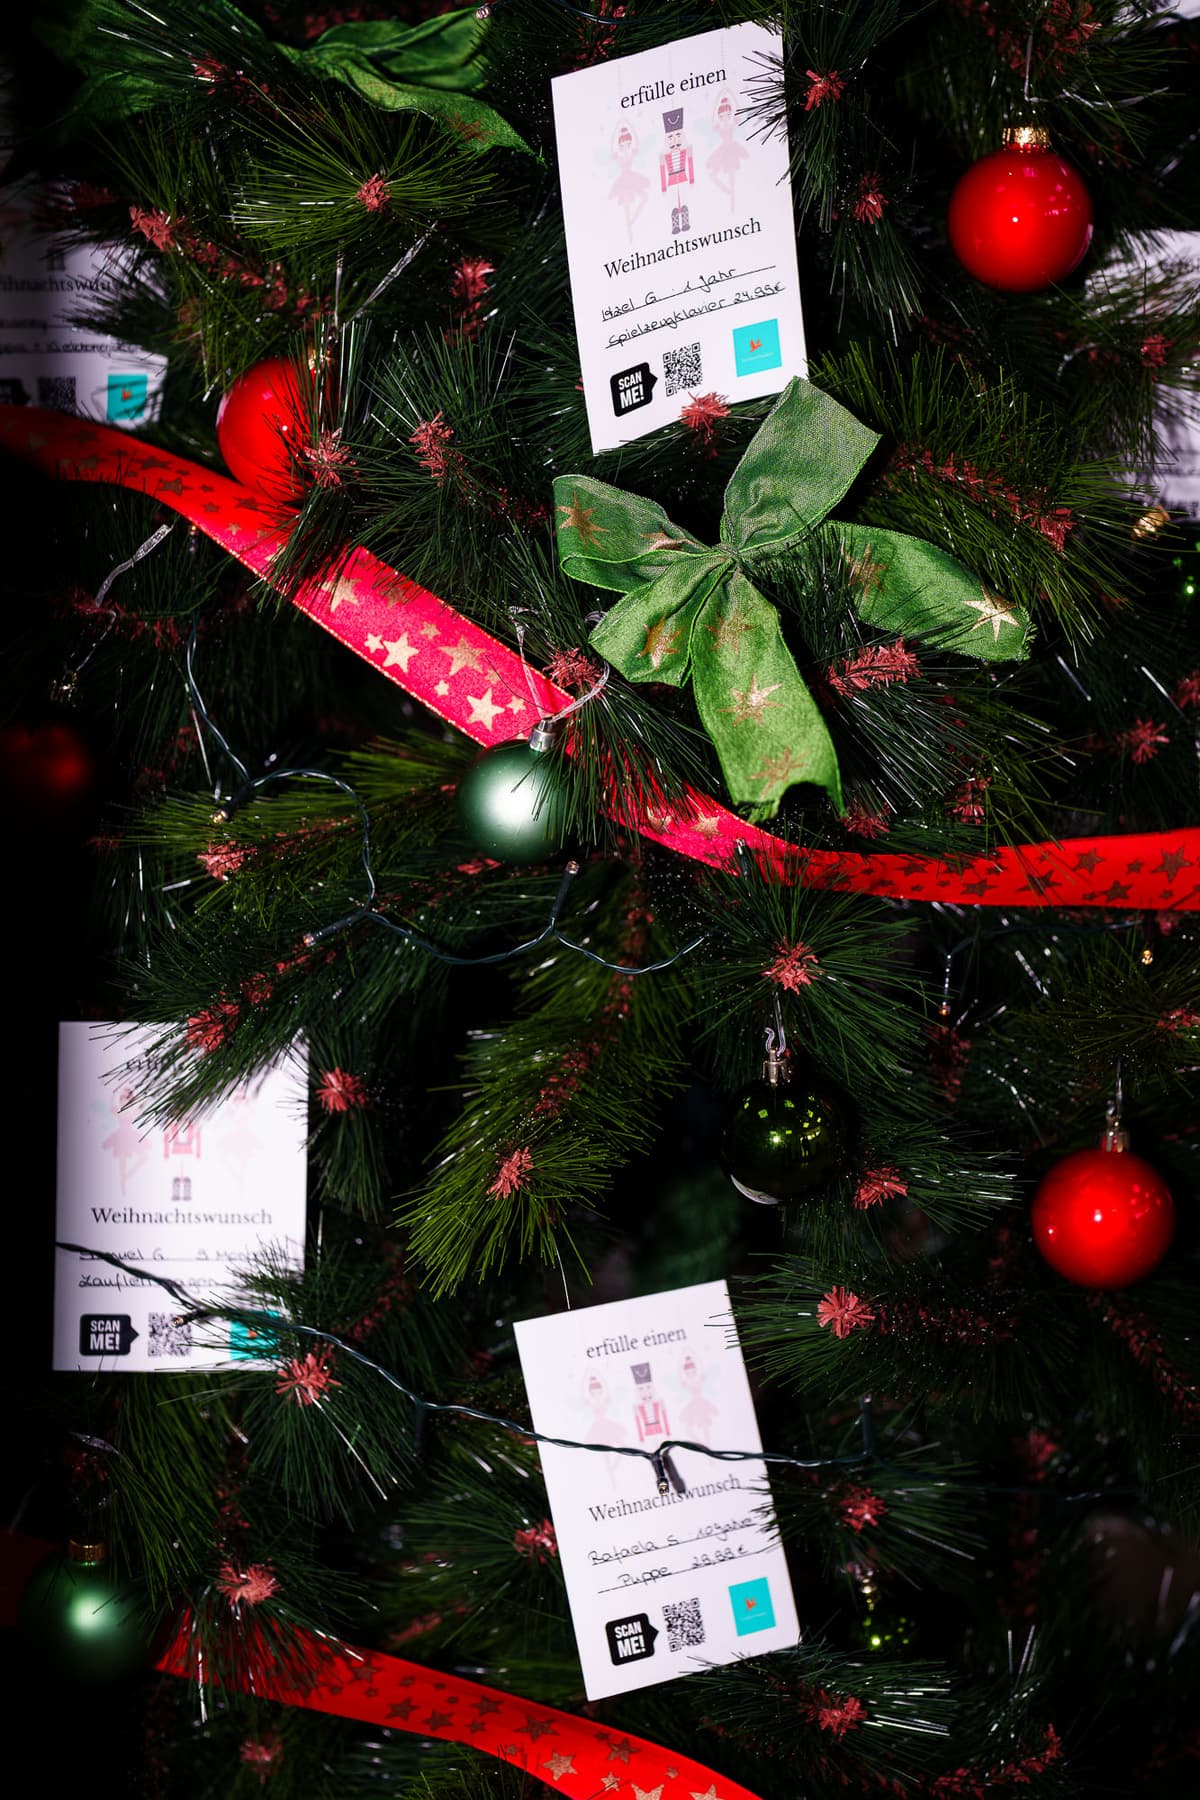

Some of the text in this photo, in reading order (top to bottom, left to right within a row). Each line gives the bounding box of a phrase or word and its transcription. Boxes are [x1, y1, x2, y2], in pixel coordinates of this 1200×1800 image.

[620, 68, 727, 109] erfülle einen
[603, 218, 762, 279] Weihnachtswunsch
[699, 269, 736, 293] Jahr
[618, 371, 643, 391] SCAN
[619, 388, 645, 409] ME!
[90, 1207, 273, 1225] Weihnachtswunsch
[90, 1320, 121, 1332] SCAN
[89, 1333, 121, 1350] ME!
[586, 1328, 688, 1359] erfülle einen
[588, 1473, 741, 1522] Weihnachtswunsch
[588, 1540, 658, 1566] Rafaela
[618, 1566, 673, 1588] Puppe
[614, 1621, 642, 1640] SCAN
[616, 1634, 646, 1659] ME!
